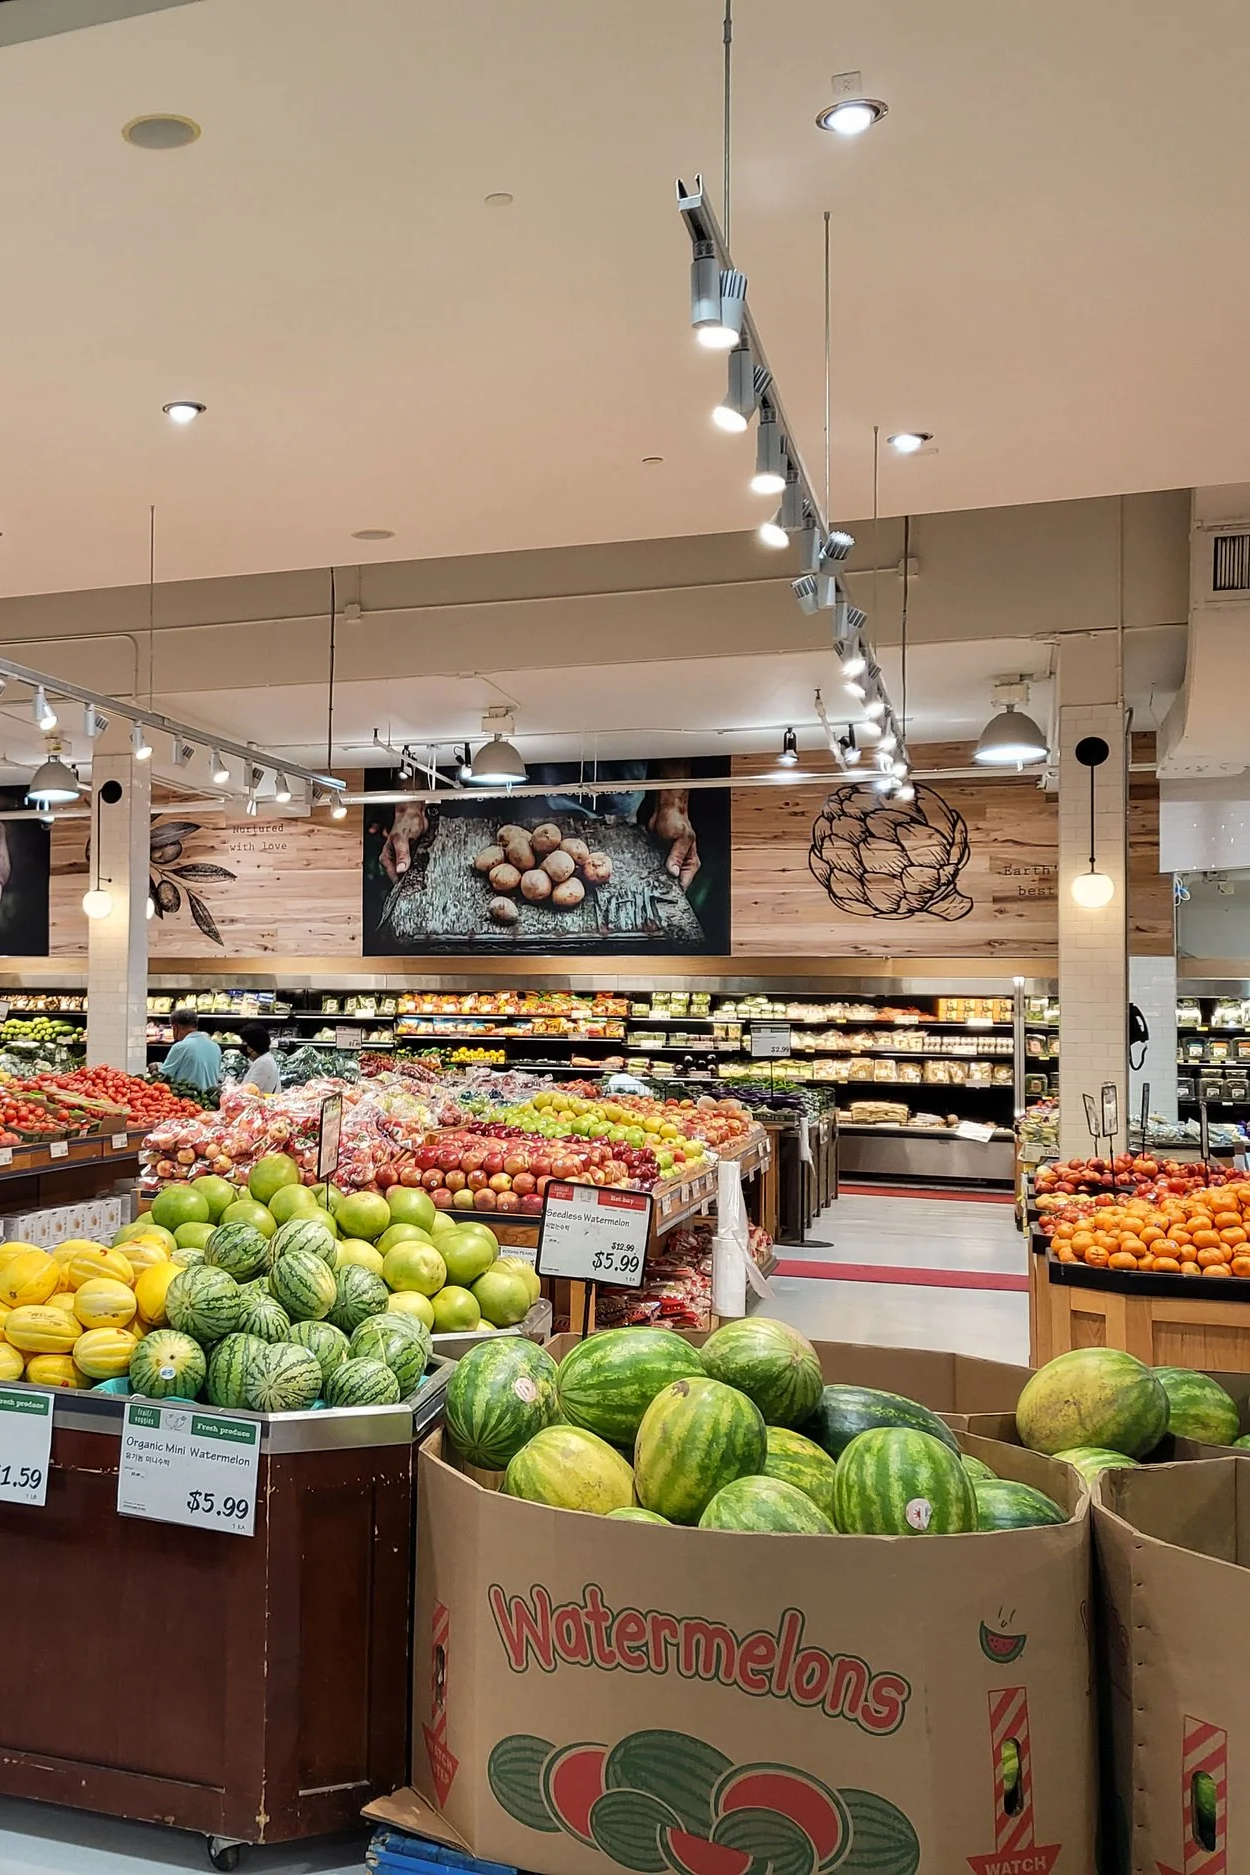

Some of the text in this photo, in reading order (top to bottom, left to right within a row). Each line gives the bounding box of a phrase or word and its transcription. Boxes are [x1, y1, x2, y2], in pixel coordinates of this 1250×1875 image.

[232, 823, 284, 834] Nurtured
[230, 842, 287, 851] with love
[1002, 864, 1058, 876] Earth'
[1017, 885, 1055, 896] best
[546, 1208, 630, 1228] Seedless Watermelon
[611, 1242, 635, 1253] $12.99
[592, 1250, 640, 1273] $5.99
[15, 1400, 45, 1409] produce
[197, 1423, 251, 1438] Fresh produce
[126, 1436, 251, 1467] Organic Mini Watermelon
[186, 1489, 250, 1520] $5.99
[488, 1583, 912, 1737] Watermelons
[984, 1856, 1047, 1875] WATCH
